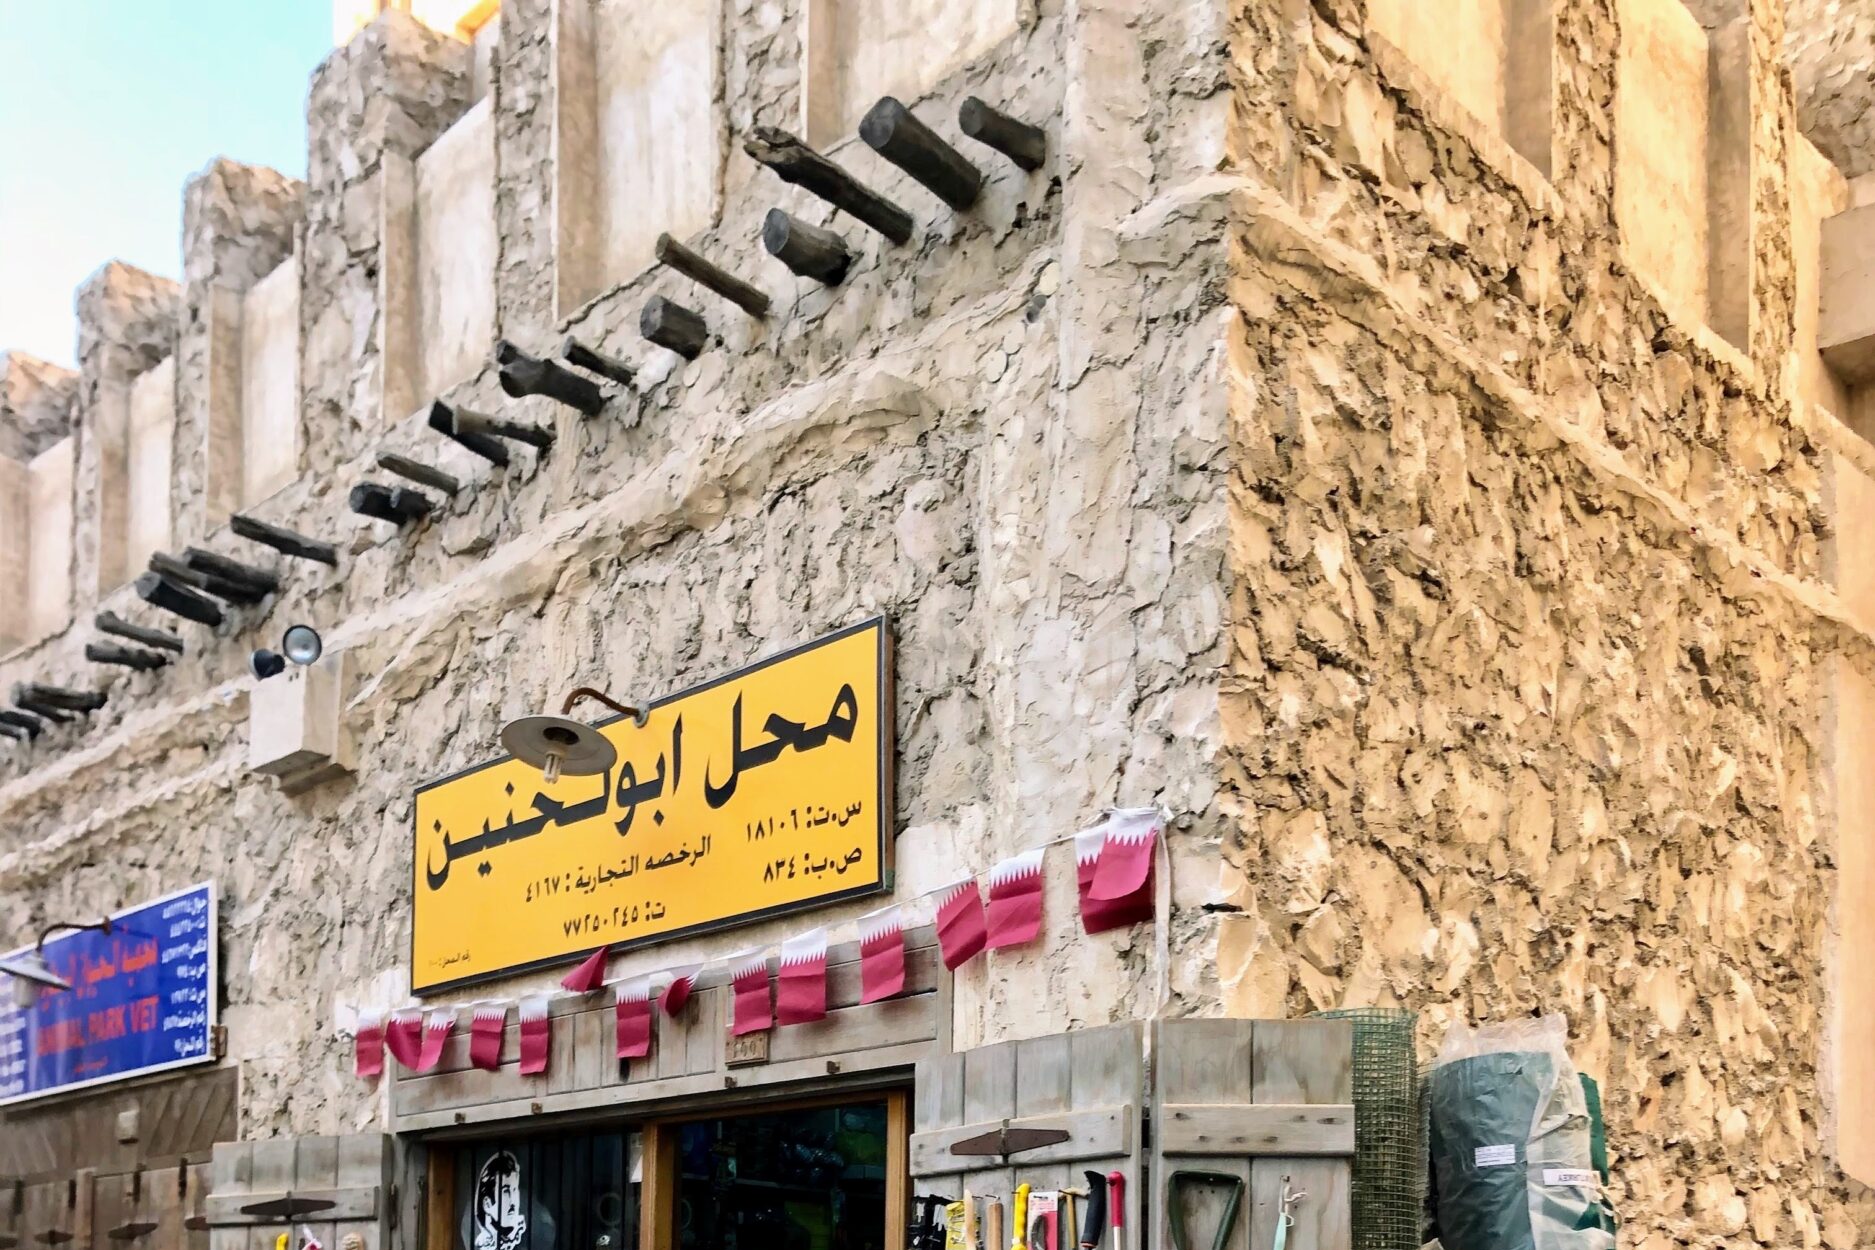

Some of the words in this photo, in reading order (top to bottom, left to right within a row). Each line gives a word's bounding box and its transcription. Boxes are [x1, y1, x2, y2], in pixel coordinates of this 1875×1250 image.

[703, 682, 859, 810] محل
[746, 808, 799, 843] ١٨١٠٦
[644, 834, 712, 871] الرخصه
[763, 855, 797, 885] ٨٣٤
[525, 875, 561, 903] ٤١٦٧
[563, 905, 640, 939] ٧٧٢٥٠٢٤٥
